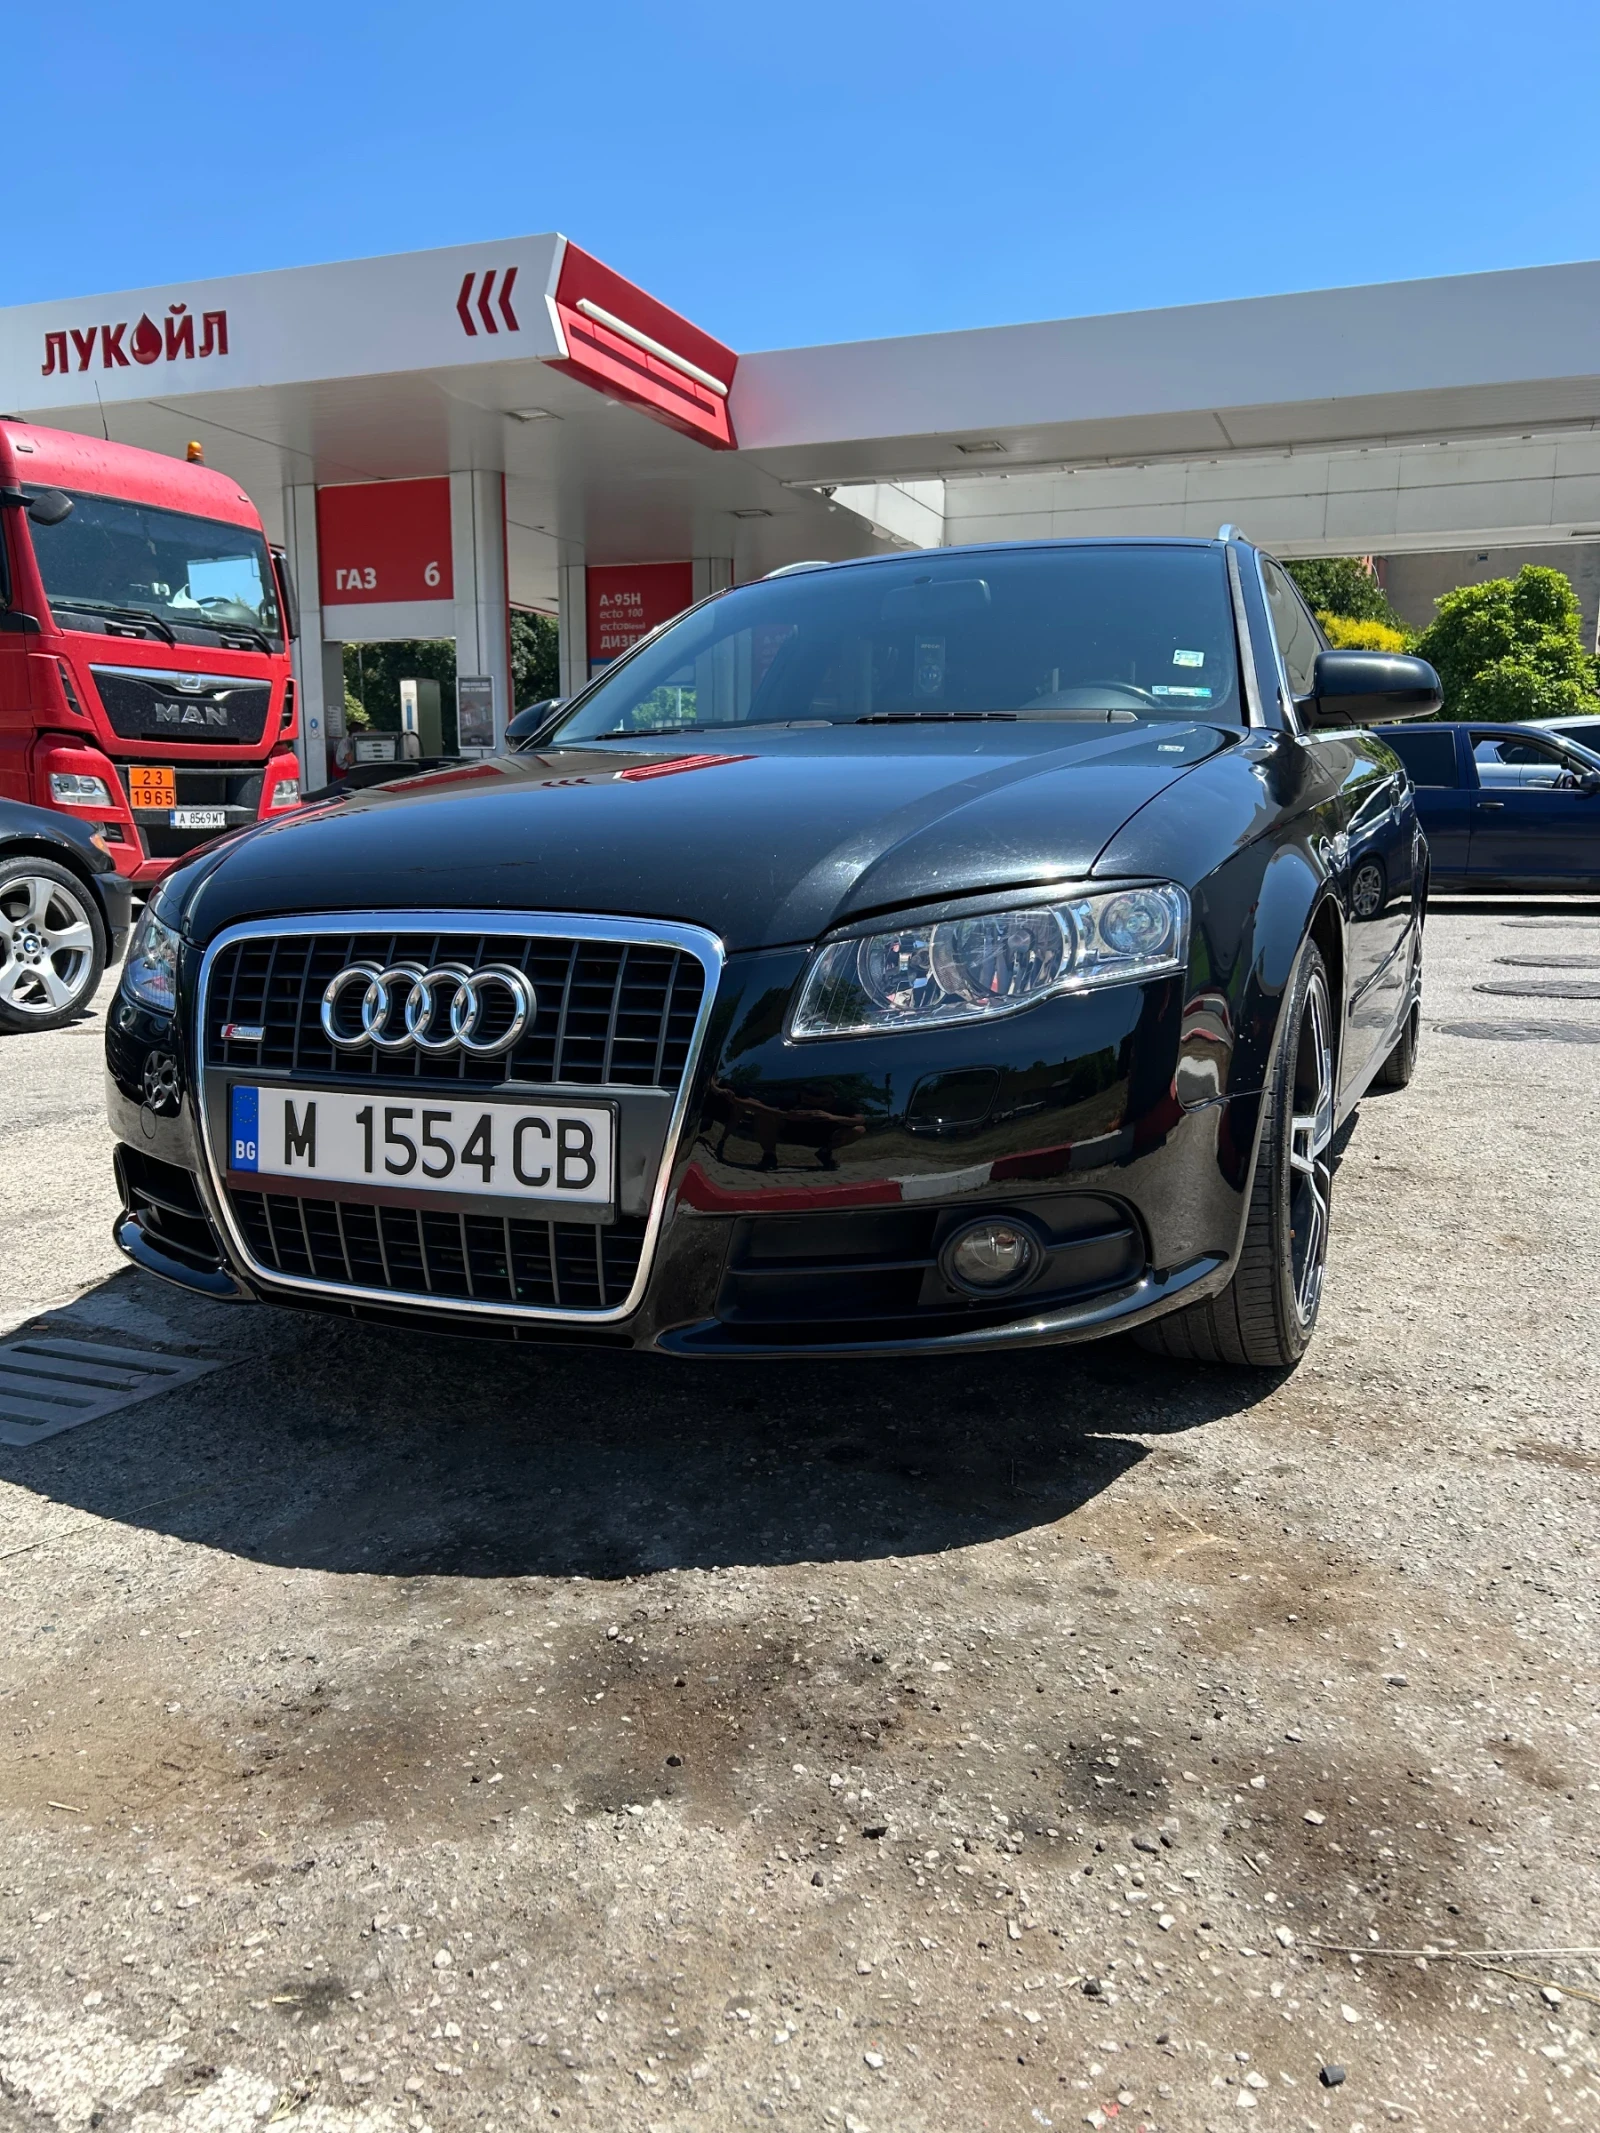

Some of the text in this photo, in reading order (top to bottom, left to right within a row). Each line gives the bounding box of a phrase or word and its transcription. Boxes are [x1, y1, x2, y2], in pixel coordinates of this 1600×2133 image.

[41, 302, 229, 377] ЛУКОЙЛ
[335, 561, 441, 591] ГАЗ 6
[600, 608, 643, 619] ecto 100
[154, 702, 228, 726] MAN
[133, 790, 173, 806] 1965
[284, 1099, 316, 1168] M
[235, 1140, 256, 1161] BG
